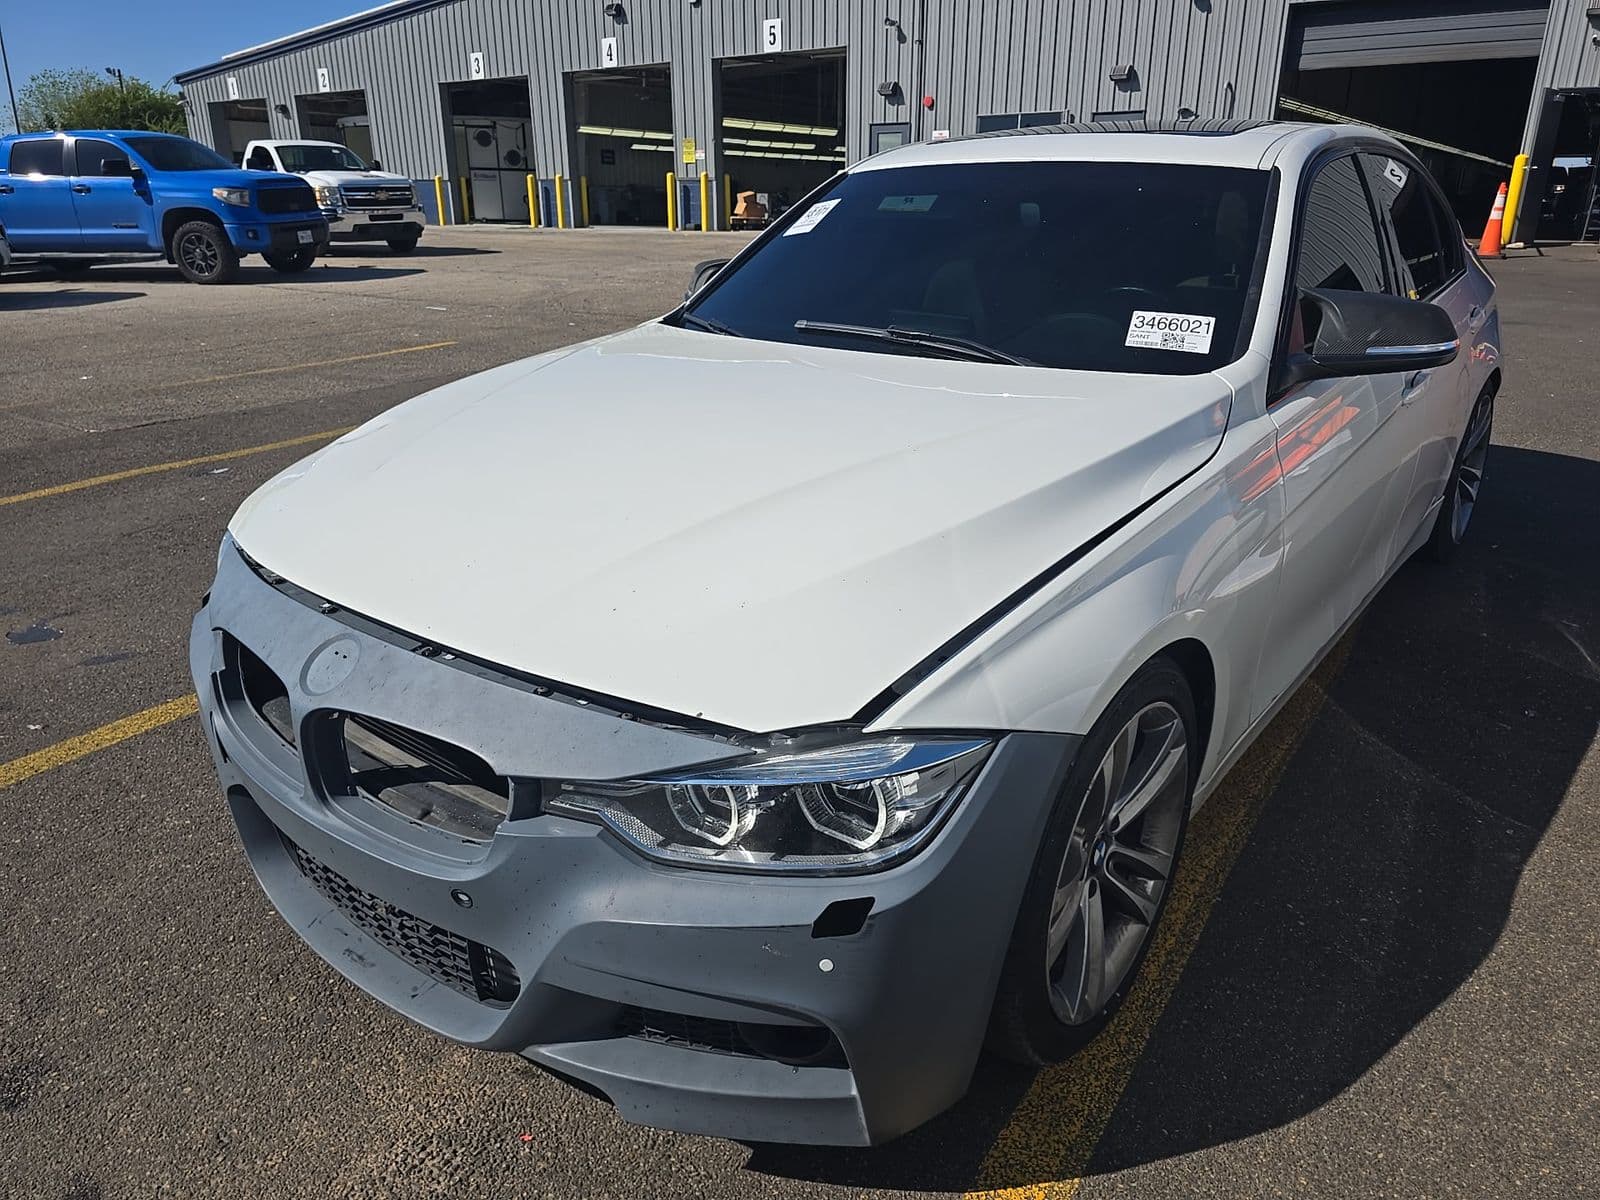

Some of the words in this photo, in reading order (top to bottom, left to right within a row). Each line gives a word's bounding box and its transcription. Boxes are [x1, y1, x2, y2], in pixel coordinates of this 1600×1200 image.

[769, 25, 776, 46] 5
[606, 43, 613, 61] 4
[474, 57, 480, 74] 3
[321, 72, 327, 88] 2
[231, 82, 236, 96] 1
[1134, 315, 1211, 335] 3466021
